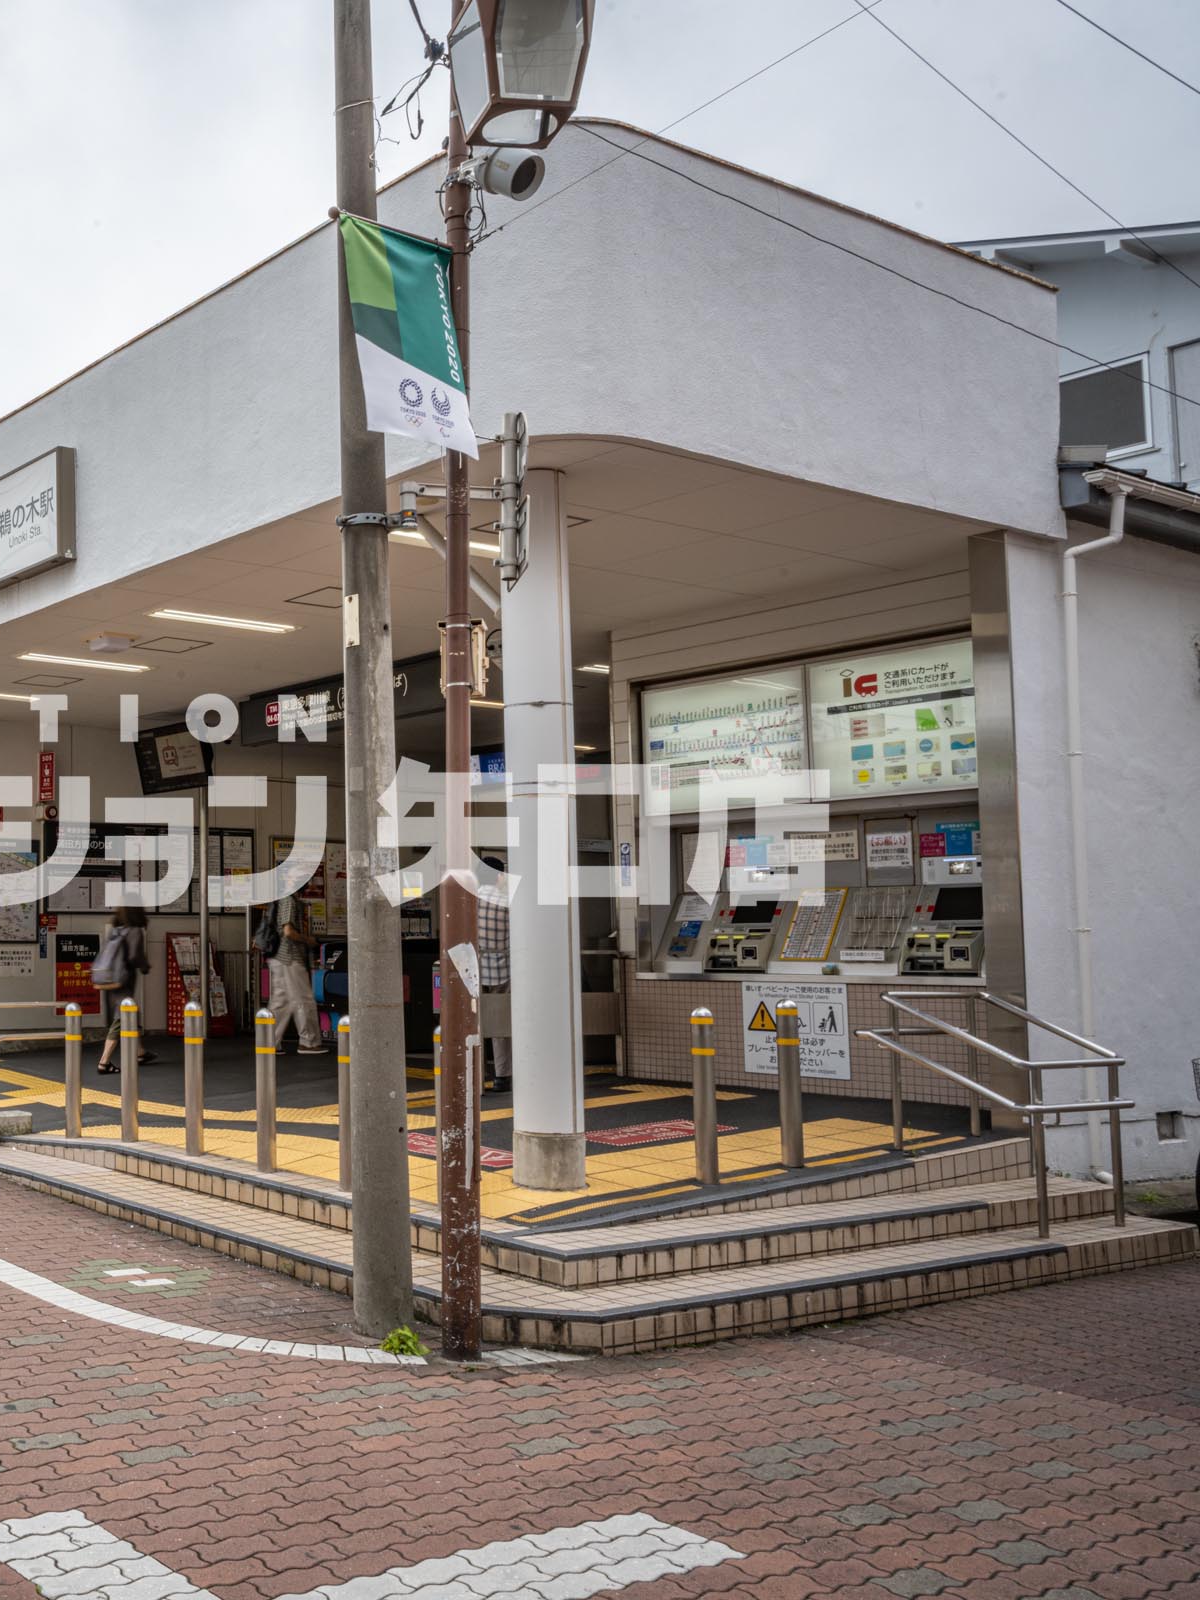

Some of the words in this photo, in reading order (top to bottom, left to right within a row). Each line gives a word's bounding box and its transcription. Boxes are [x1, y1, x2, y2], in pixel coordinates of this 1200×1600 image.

[8, 531, 28, 548] Unoki
[884, 662, 949, 681] 交通系ICカードが
[884, 671, 956, 689] ご利用いただけます
